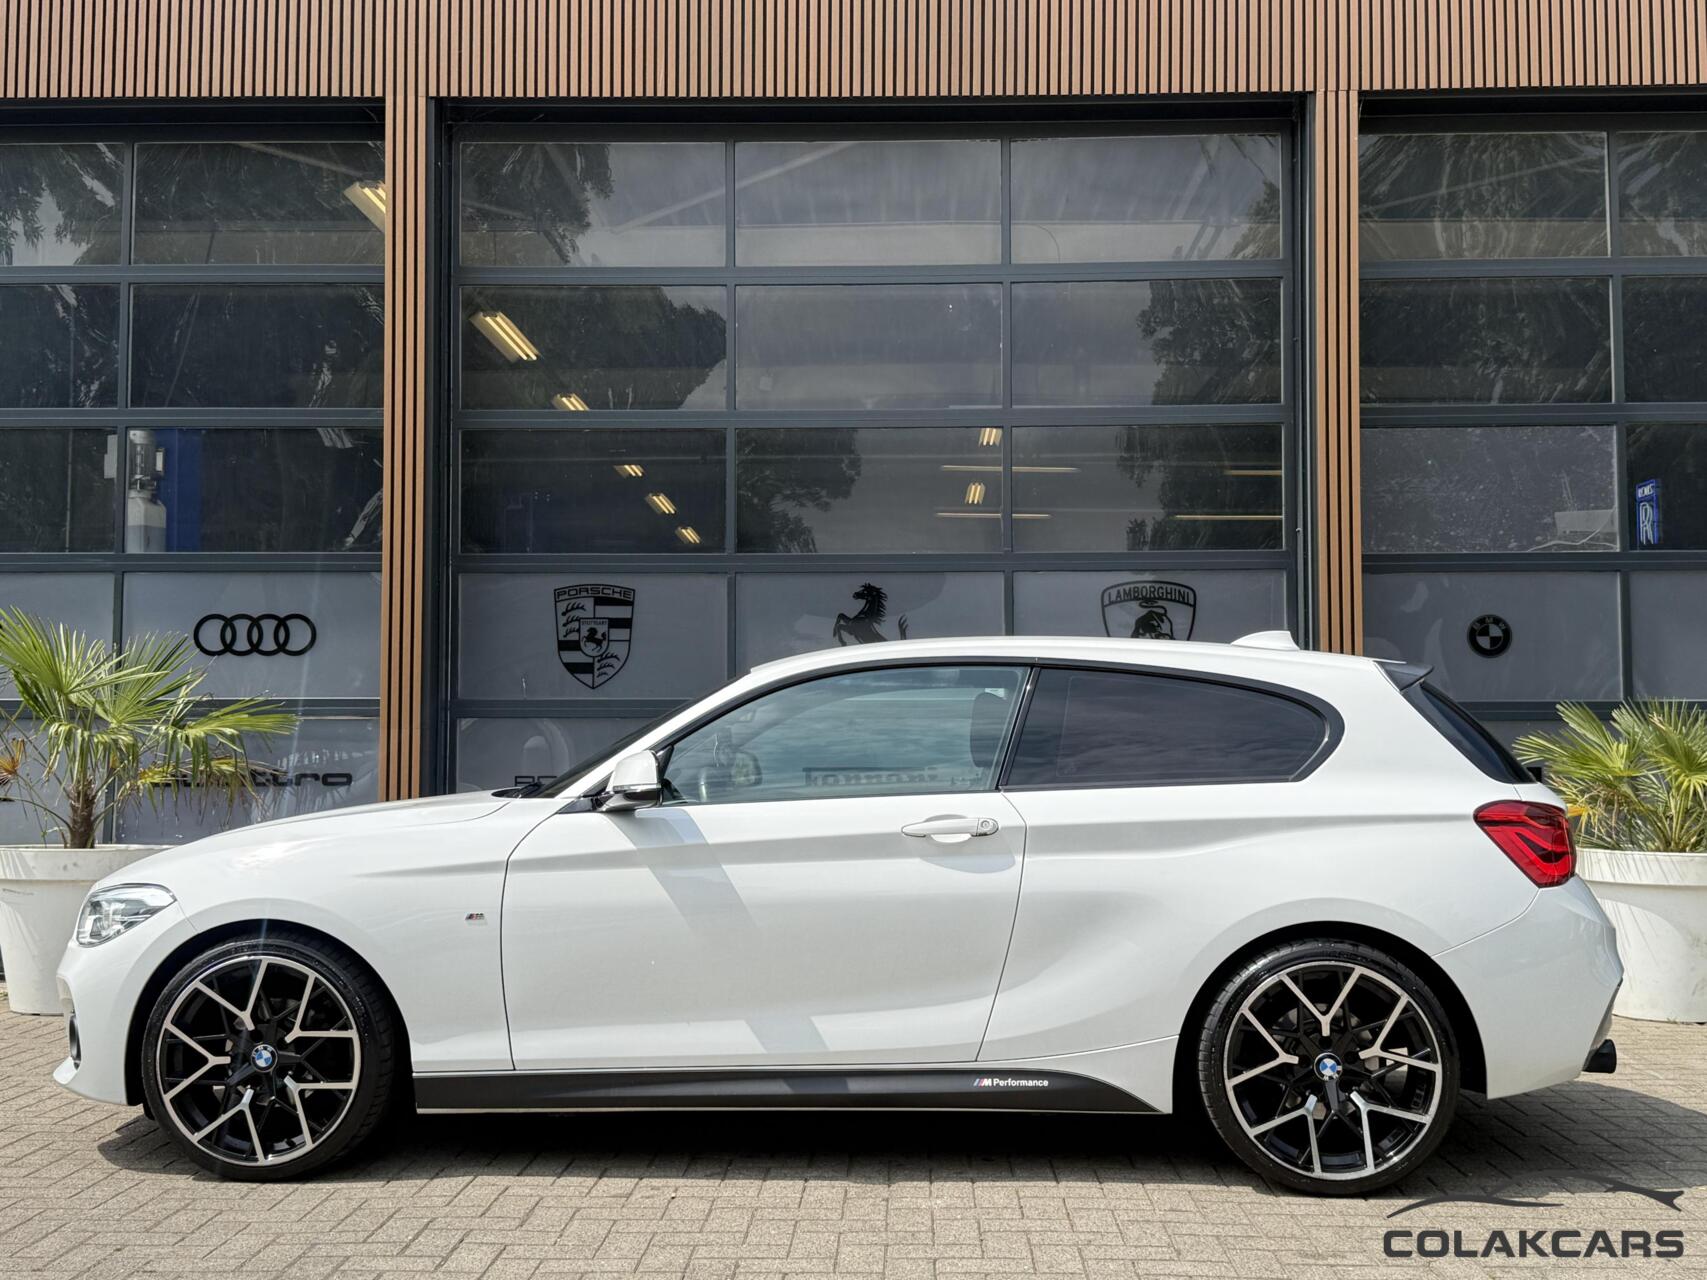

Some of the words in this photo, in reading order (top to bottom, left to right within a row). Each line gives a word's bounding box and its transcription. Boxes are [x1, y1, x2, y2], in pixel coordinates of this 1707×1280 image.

[556, 587, 633, 600] PORSCHE
[1107, 585, 1191, 603] LAMBORGHINI
[993, 1078, 1049, 1087] Performance
